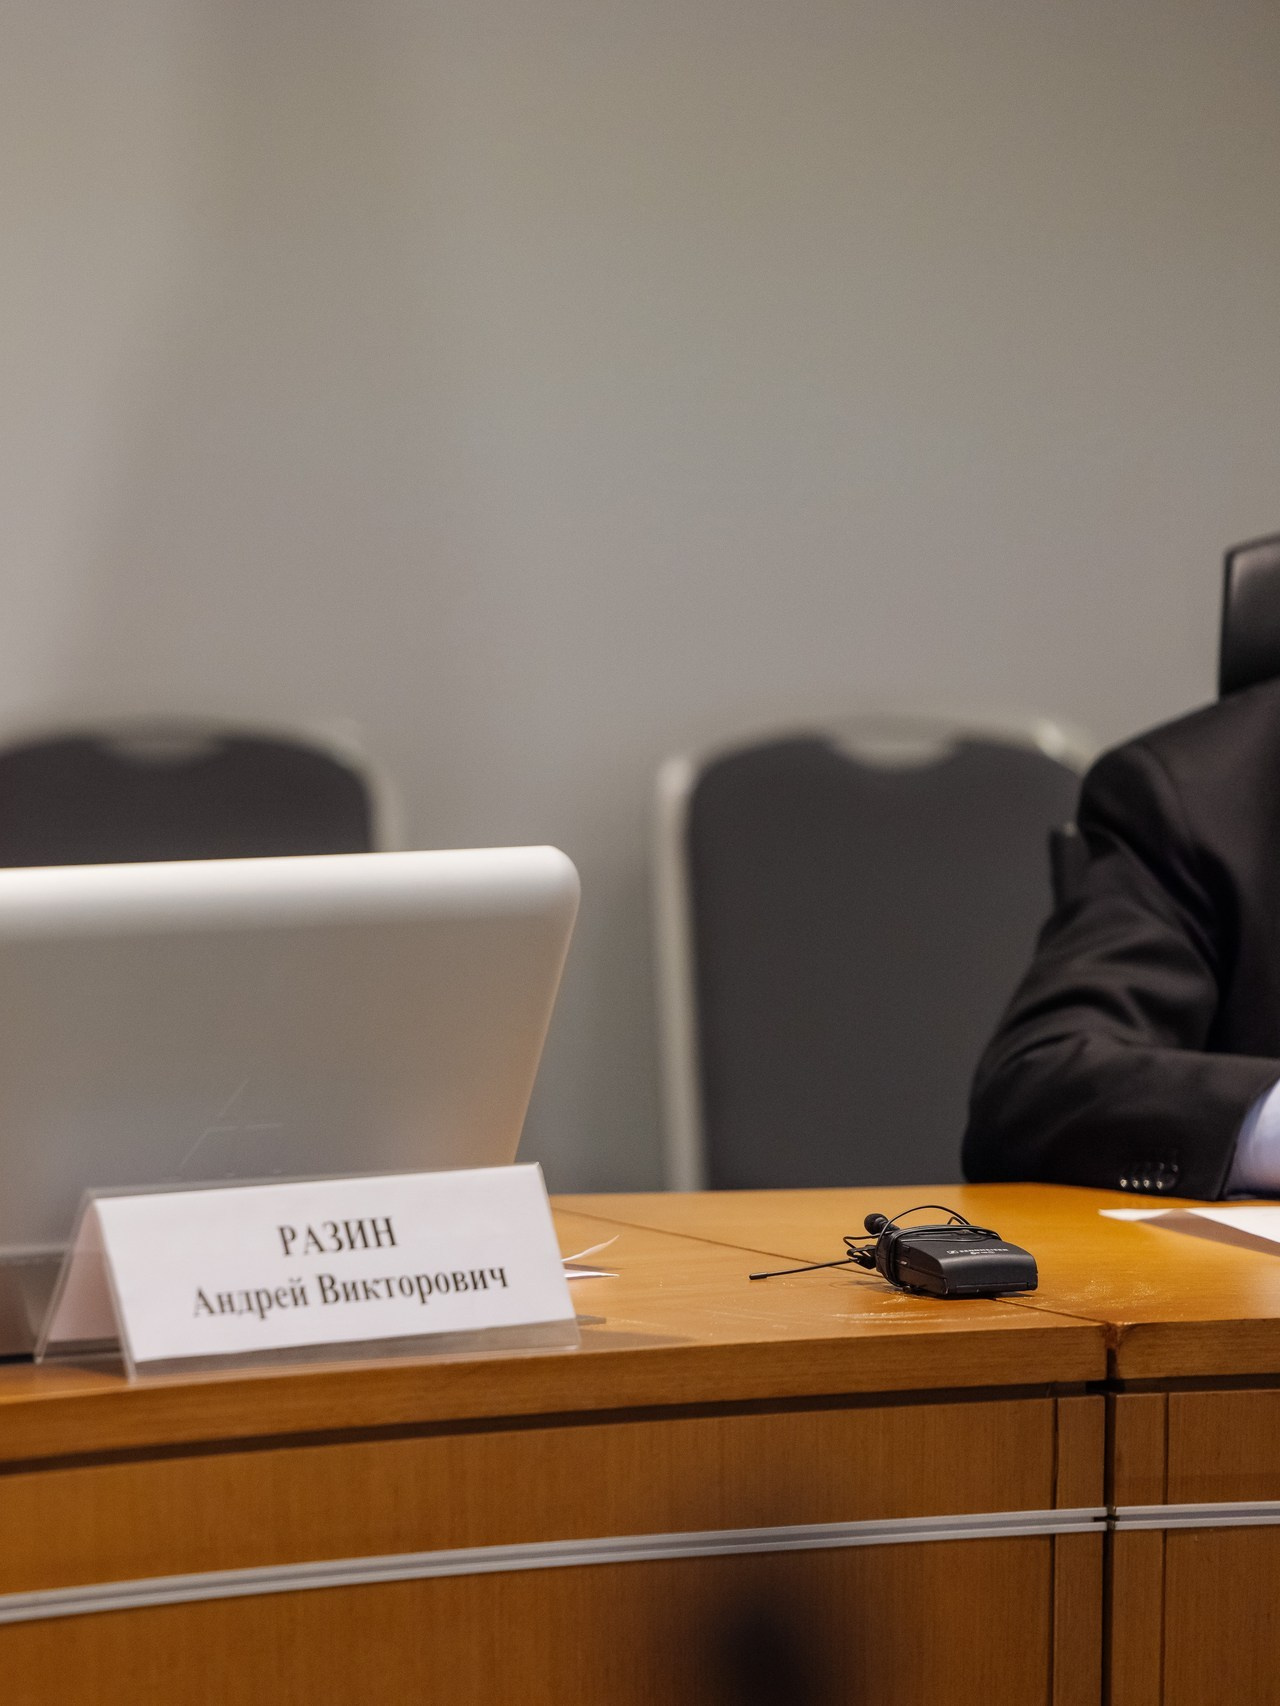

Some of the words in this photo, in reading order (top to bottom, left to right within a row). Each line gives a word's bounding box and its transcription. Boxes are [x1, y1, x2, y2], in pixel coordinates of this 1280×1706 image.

[278, 1216, 397, 1256] РАЗИН
[193, 1278, 309, 1320] Андрей
[317, 1266, 509, 1306] Викторович
